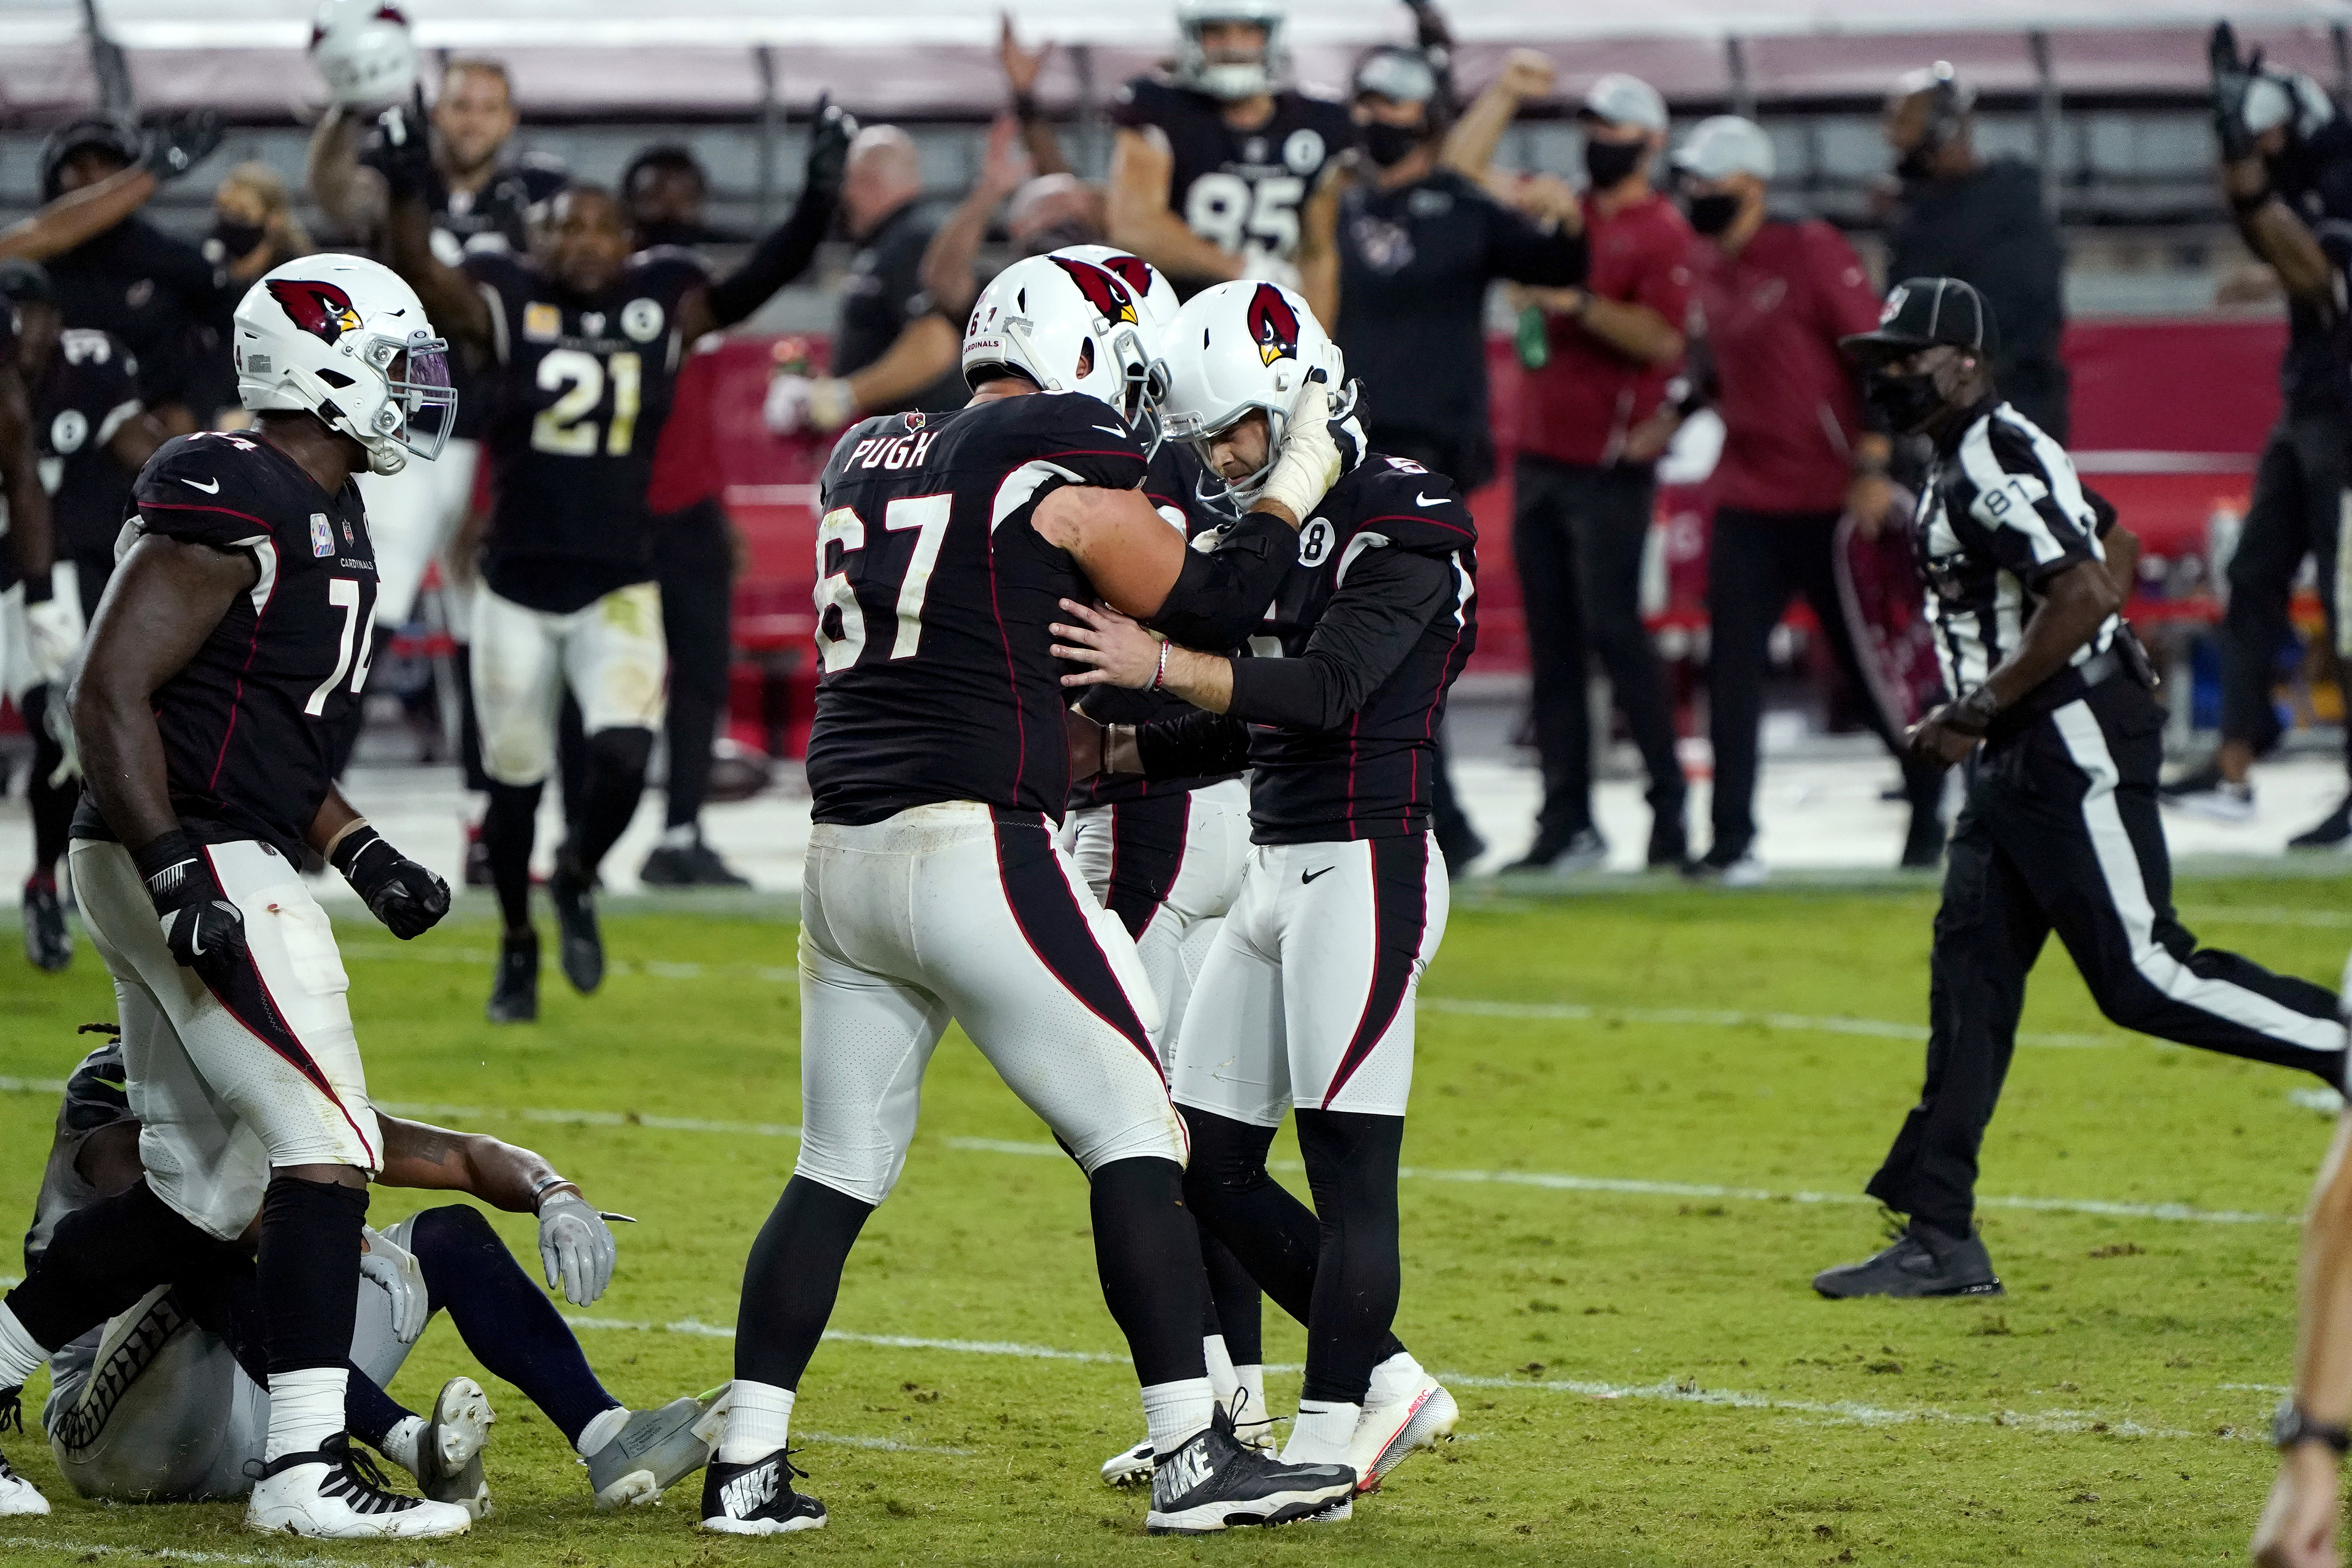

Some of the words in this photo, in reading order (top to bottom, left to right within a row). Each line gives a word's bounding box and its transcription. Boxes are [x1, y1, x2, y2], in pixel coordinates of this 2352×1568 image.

[1186, 172, 1304, 254] 95
[970, 307, 997, 336] 67
[532, 349, 641, 456] 21
[844, 432, 938, 473] PUGH
[340, 558, 374, 570] CARDINALS
[1304, 524, 1325, 560] 8
[813, 493, 955, 674] 67
[720, 1459, 779, 1519] NIKE
[1152, 1438, 1214, 1511] NIKE
